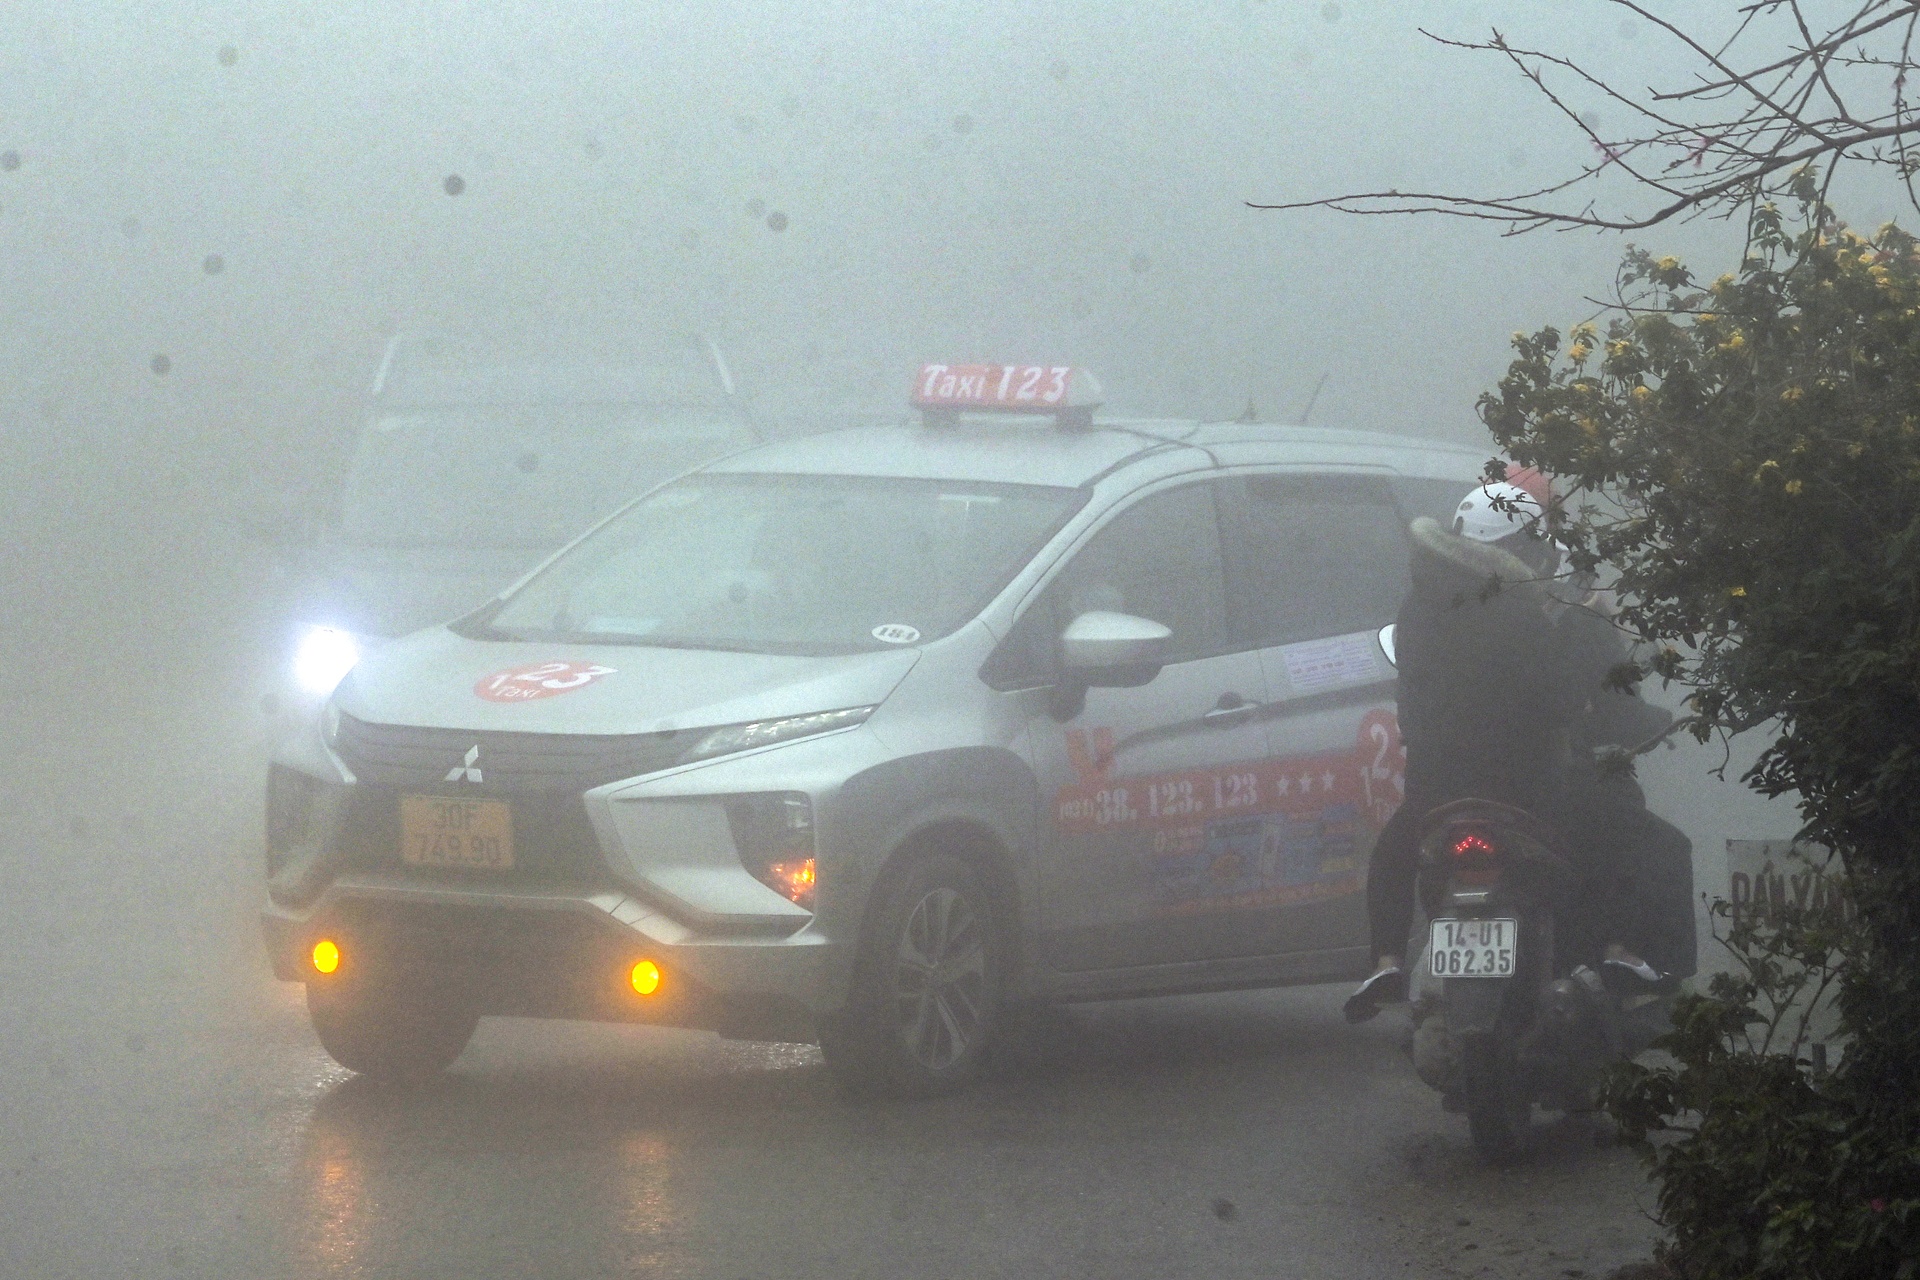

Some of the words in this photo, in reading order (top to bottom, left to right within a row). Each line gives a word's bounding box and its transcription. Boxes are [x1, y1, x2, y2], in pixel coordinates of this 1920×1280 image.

[923, 365, 989, 399] Taxi
[997, 366, 1069, 402] 123
[489, 663, 619, 689] 123
[1212, 773, 1257, 809] 123
[1444, 922, 1503, 948] 14-U1
[1434, 949, 1511, 975] 062.35
